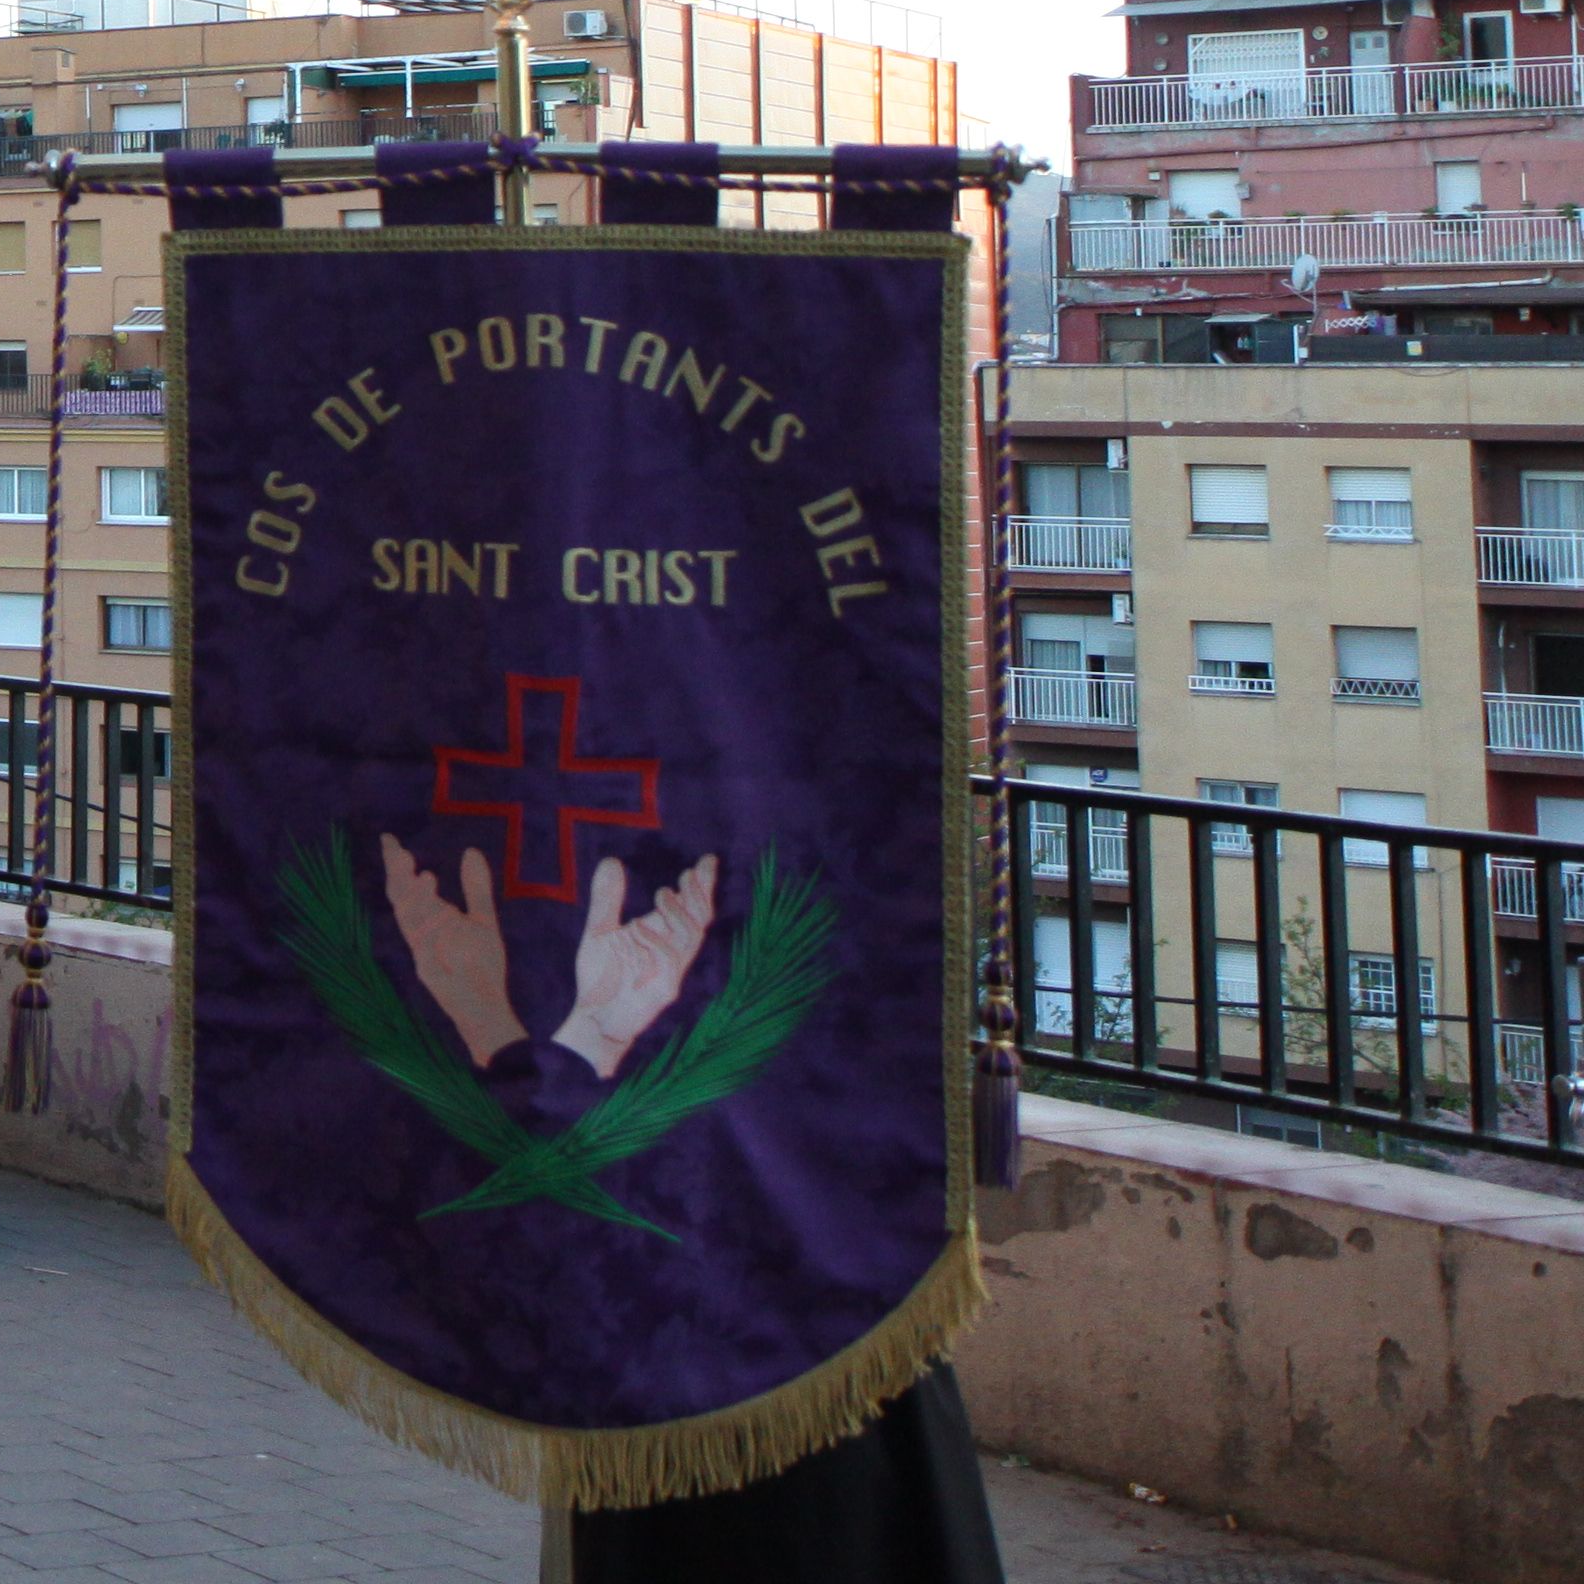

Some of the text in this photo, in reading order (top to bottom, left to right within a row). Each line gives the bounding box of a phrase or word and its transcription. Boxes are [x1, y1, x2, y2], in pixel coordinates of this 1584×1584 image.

[235, 313, 889, 617] COS DE PORTANTS DEL
[372, 537, 737, 606] SANT CRIST
